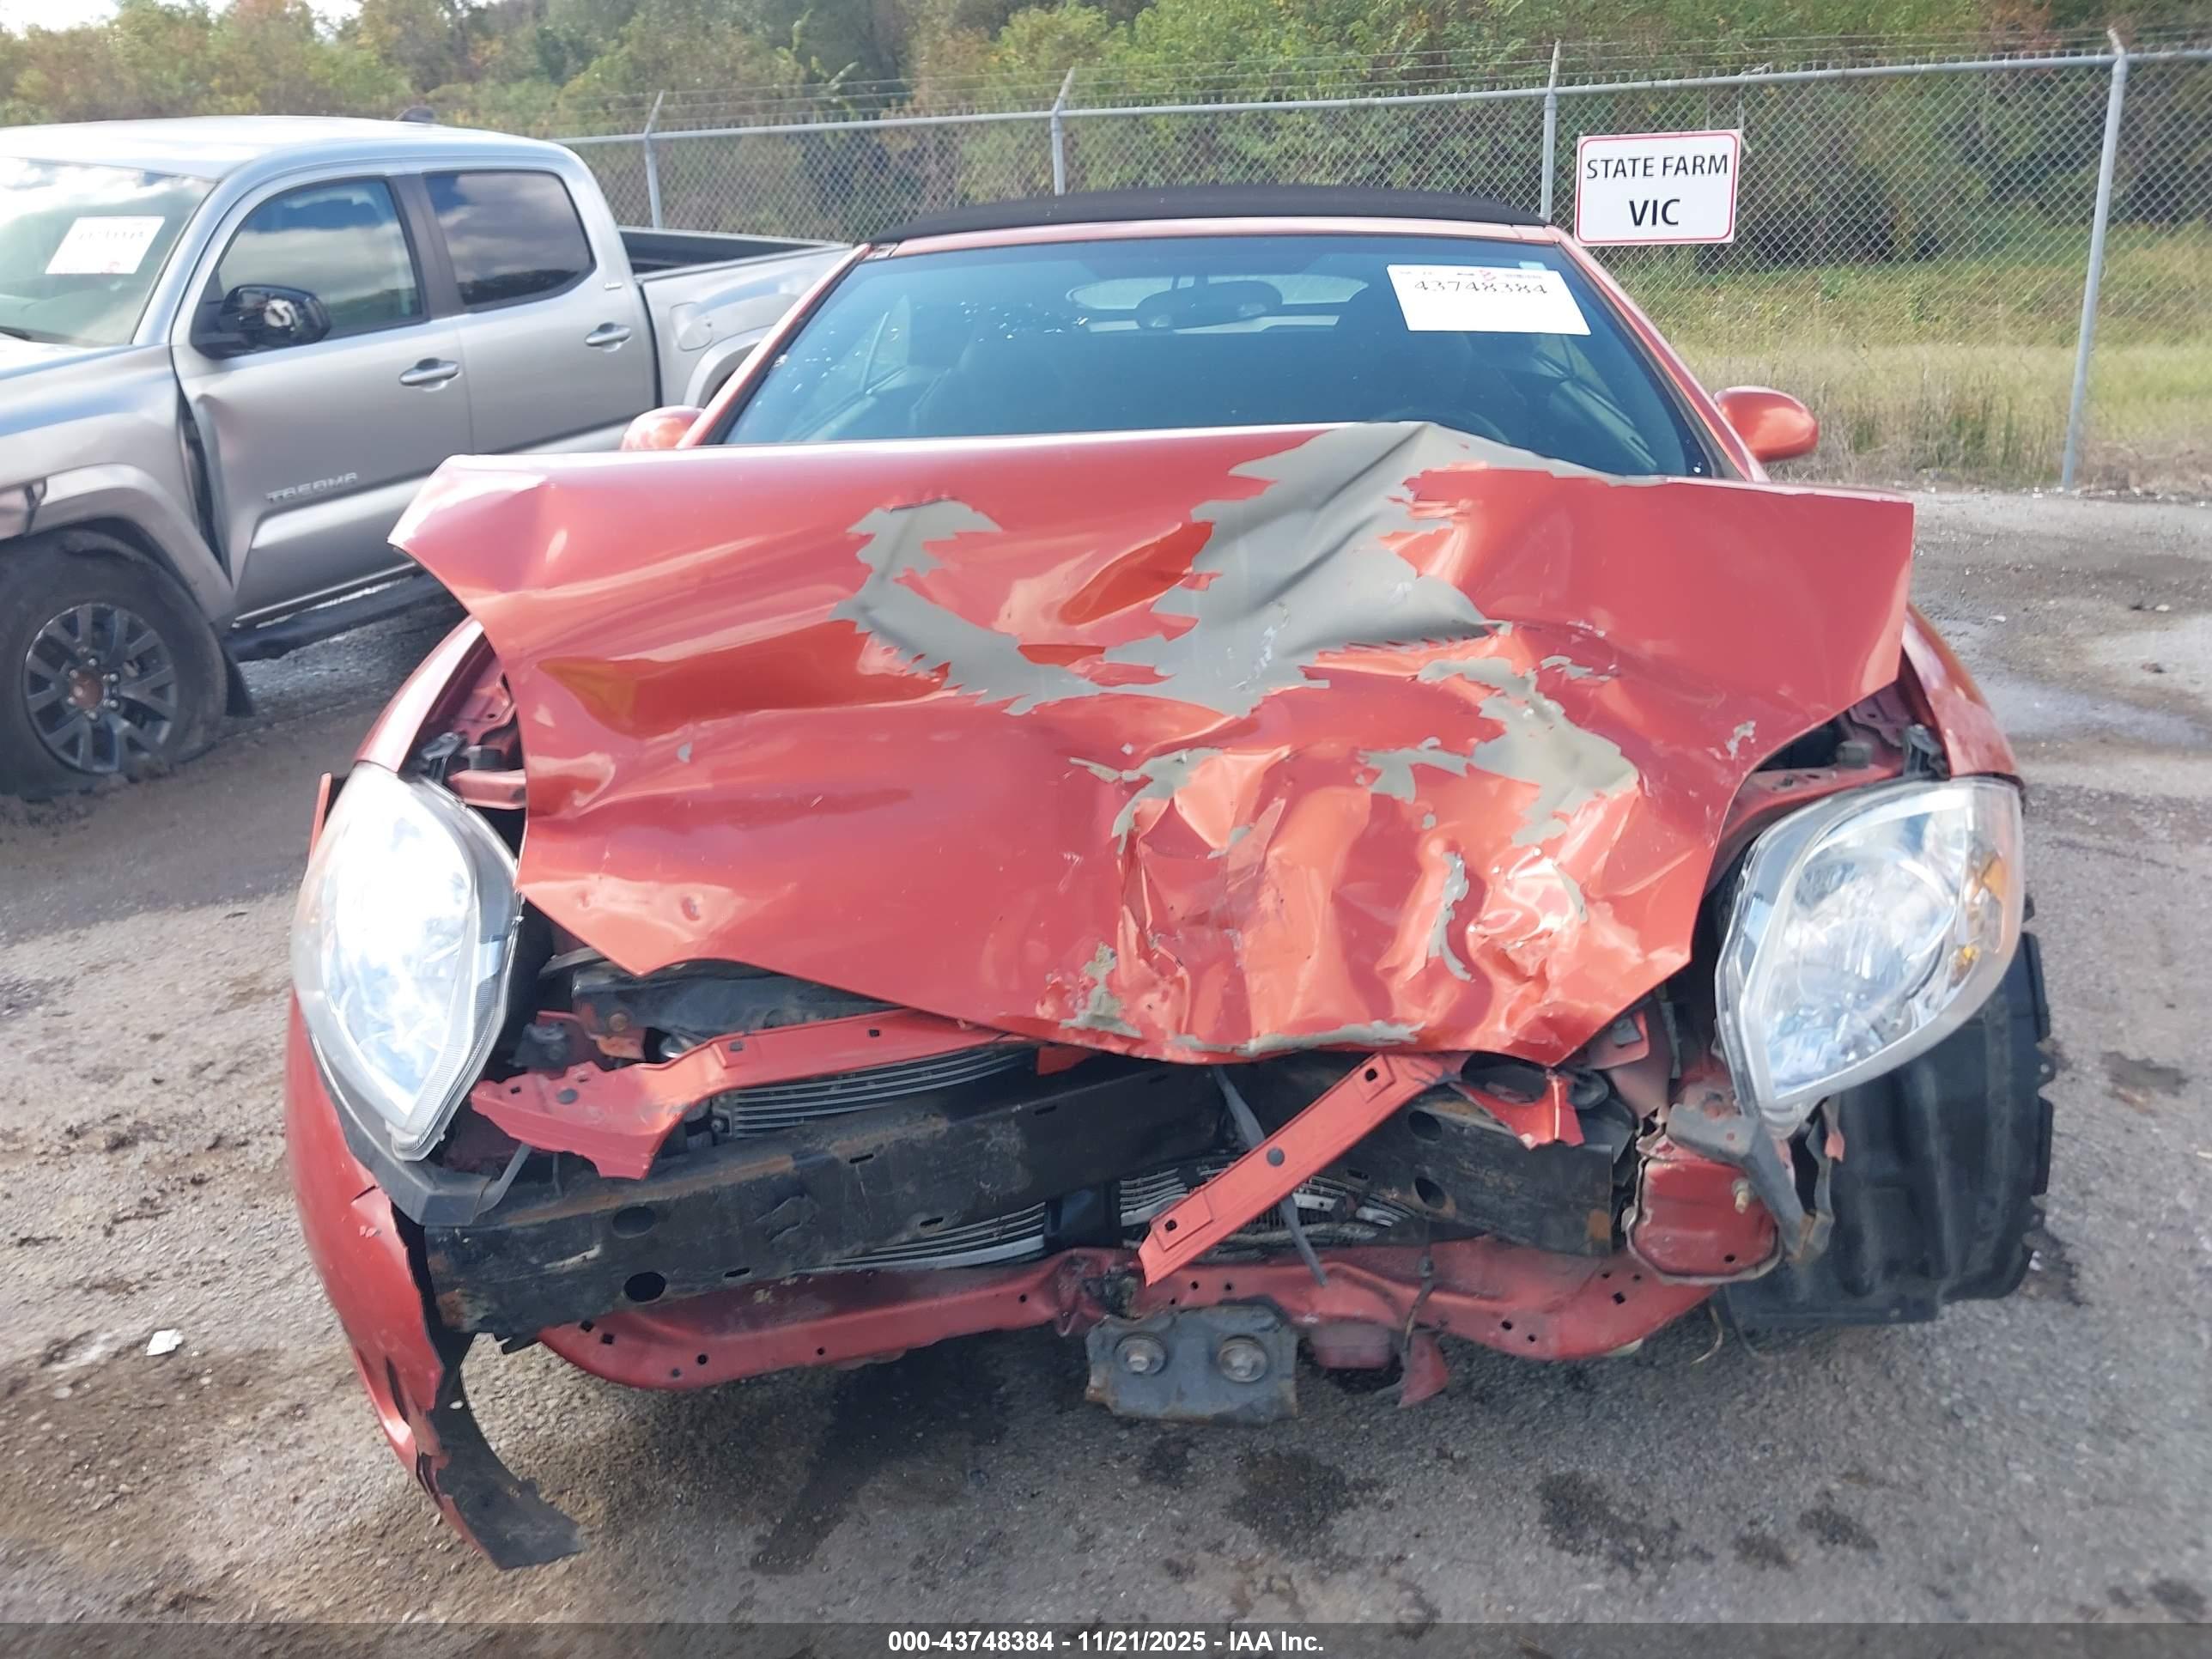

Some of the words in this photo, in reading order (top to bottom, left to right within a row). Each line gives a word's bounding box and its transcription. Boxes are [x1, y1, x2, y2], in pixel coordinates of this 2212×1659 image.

[1586, 157, 1655, 179] STATE
[1662, 155, 1729, 176] FARM
[1629, 198, 1680, 227] VIC
[1414, 279, 1547, 295] 43748384
